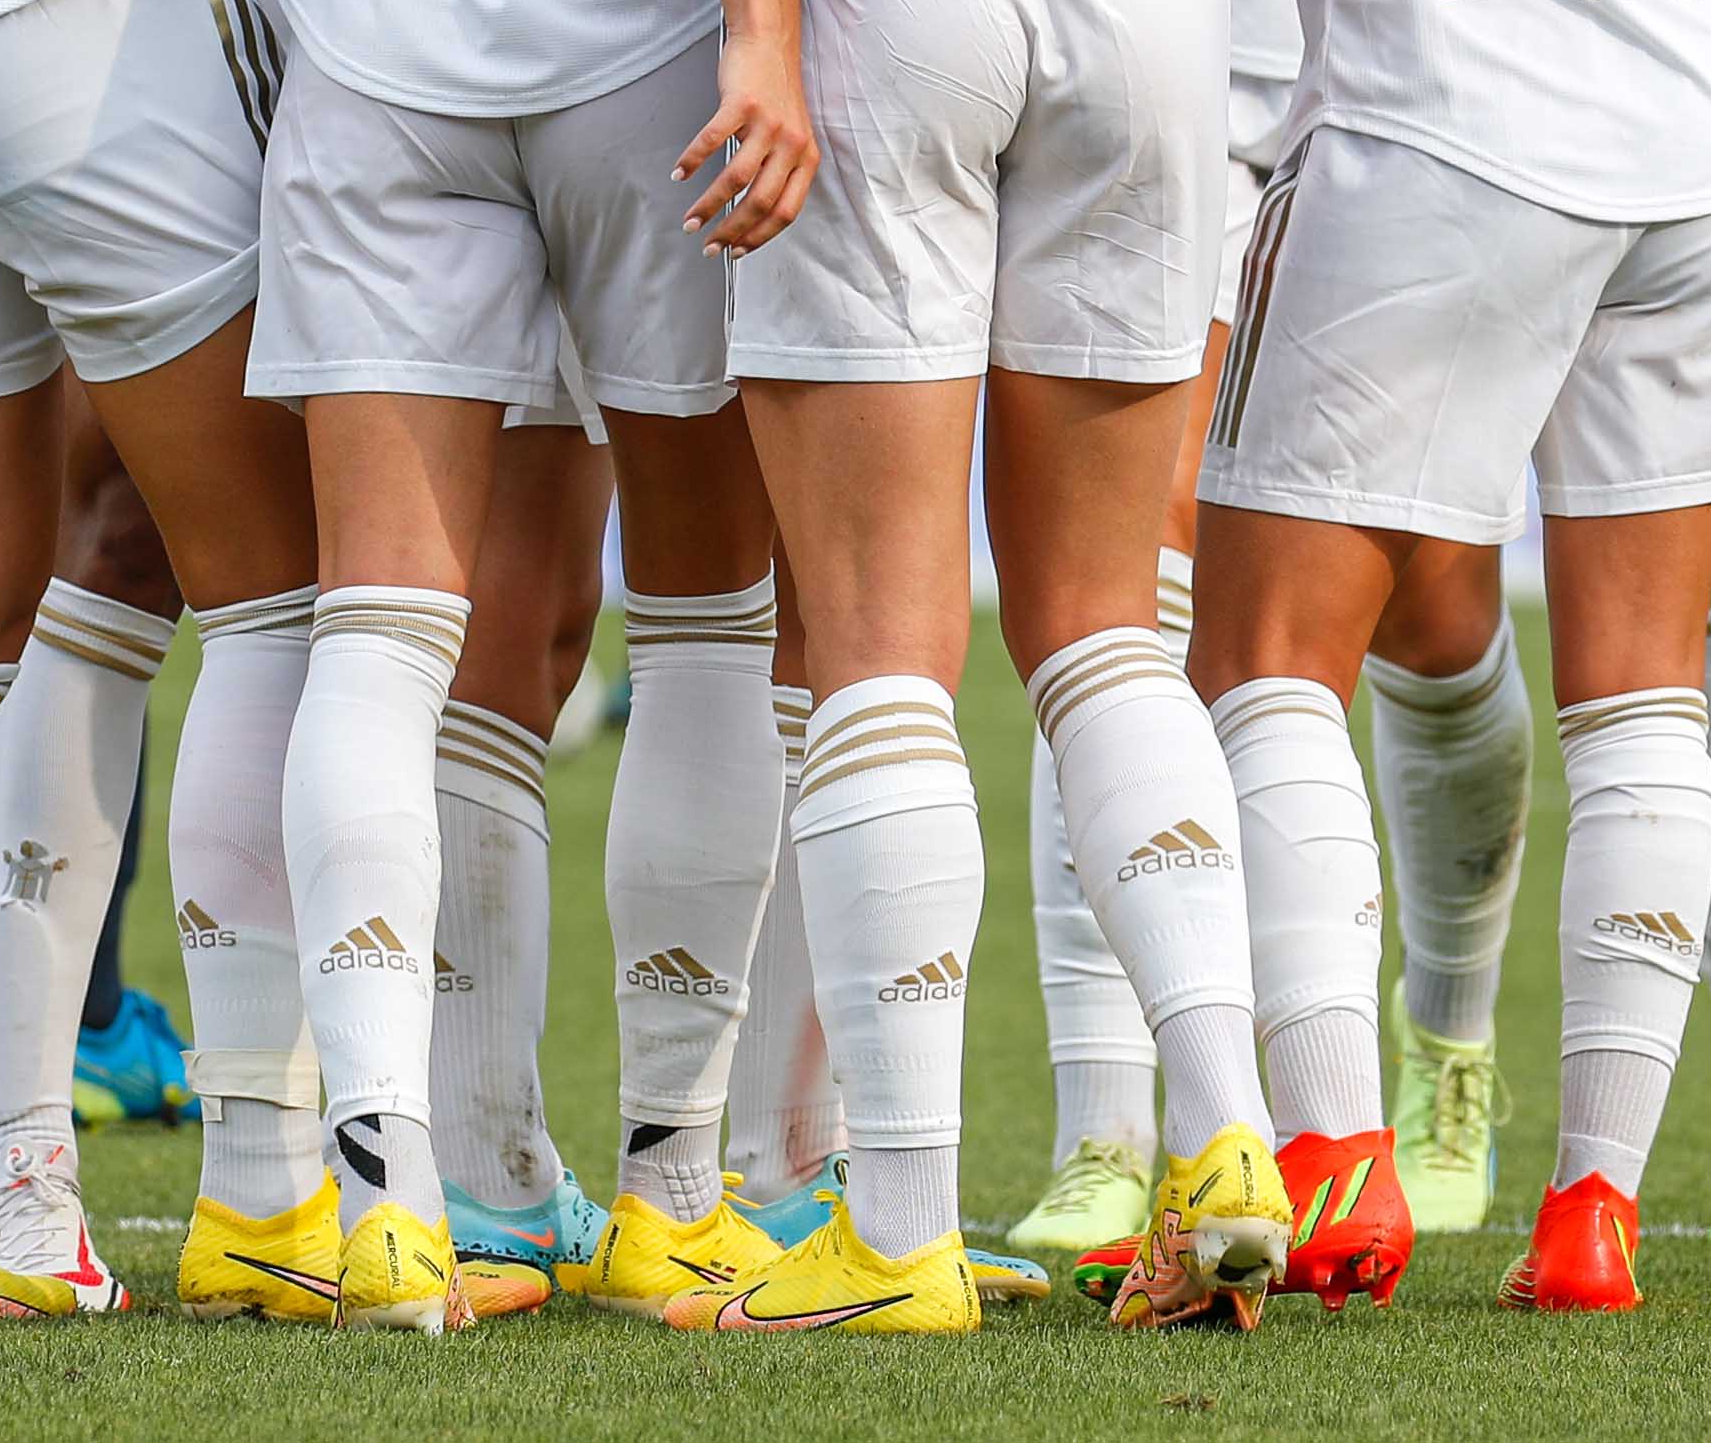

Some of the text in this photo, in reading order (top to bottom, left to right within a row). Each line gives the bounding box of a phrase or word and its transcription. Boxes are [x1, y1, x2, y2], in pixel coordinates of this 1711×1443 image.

[1117, 849, 1235, 883] adidas
[1593, 916, 1703, 957] adidas
[319, 946, 420, 975] adidas
[626, 969, 730, 997] adidas
[384, 1229, 402, 1289] MERCURIAL
[601, 1222, 621, 1284] MERCURIAL
